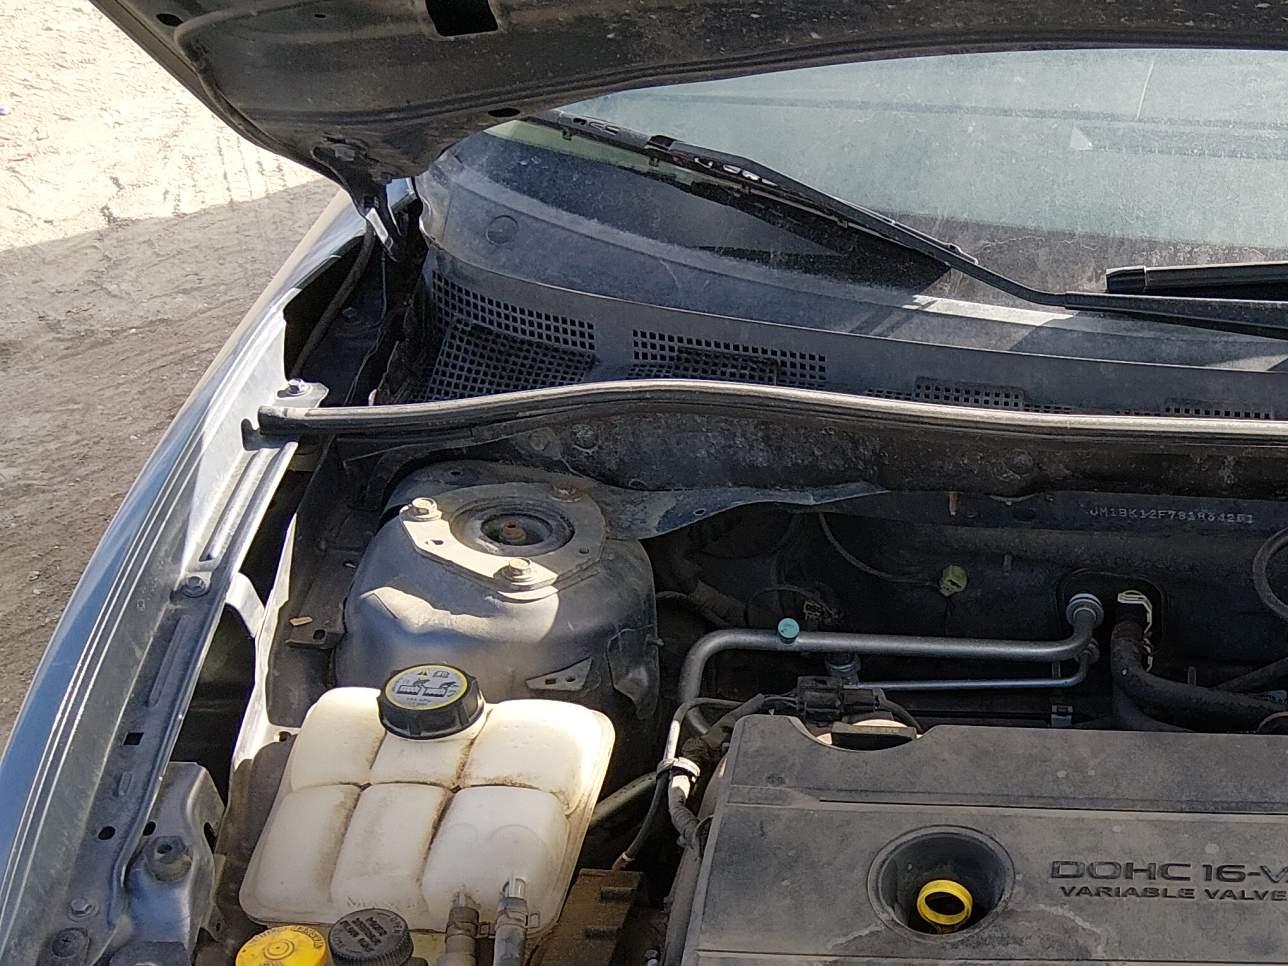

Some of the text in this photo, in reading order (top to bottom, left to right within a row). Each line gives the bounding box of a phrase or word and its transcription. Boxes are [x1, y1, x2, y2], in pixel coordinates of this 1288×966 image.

[1050, 860, 1192, 883] DOHC
[1058, 885, 1196, 900] VARIABLE
[1203, 887, 1288, 903] VALVE
